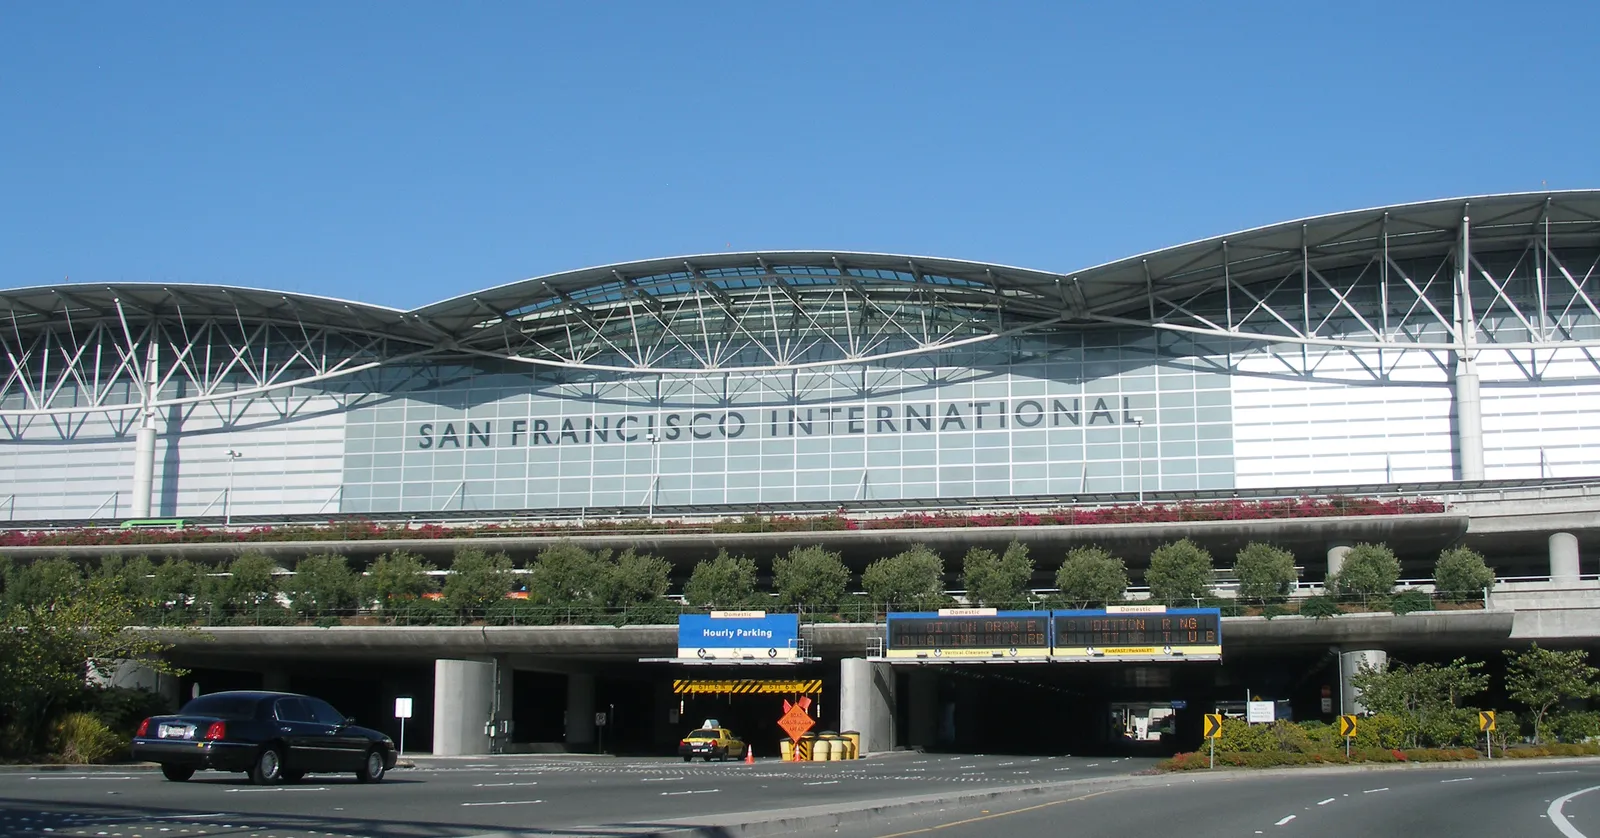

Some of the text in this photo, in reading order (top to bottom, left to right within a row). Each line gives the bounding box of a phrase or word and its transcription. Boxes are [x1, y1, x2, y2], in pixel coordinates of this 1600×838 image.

[419, 396, 1136, 449] SAN FRANCISCO INTERNATIONAL
[985, 619, 1037, 633] ORANE
[703, 628, 773, 639] Hourly Parking
